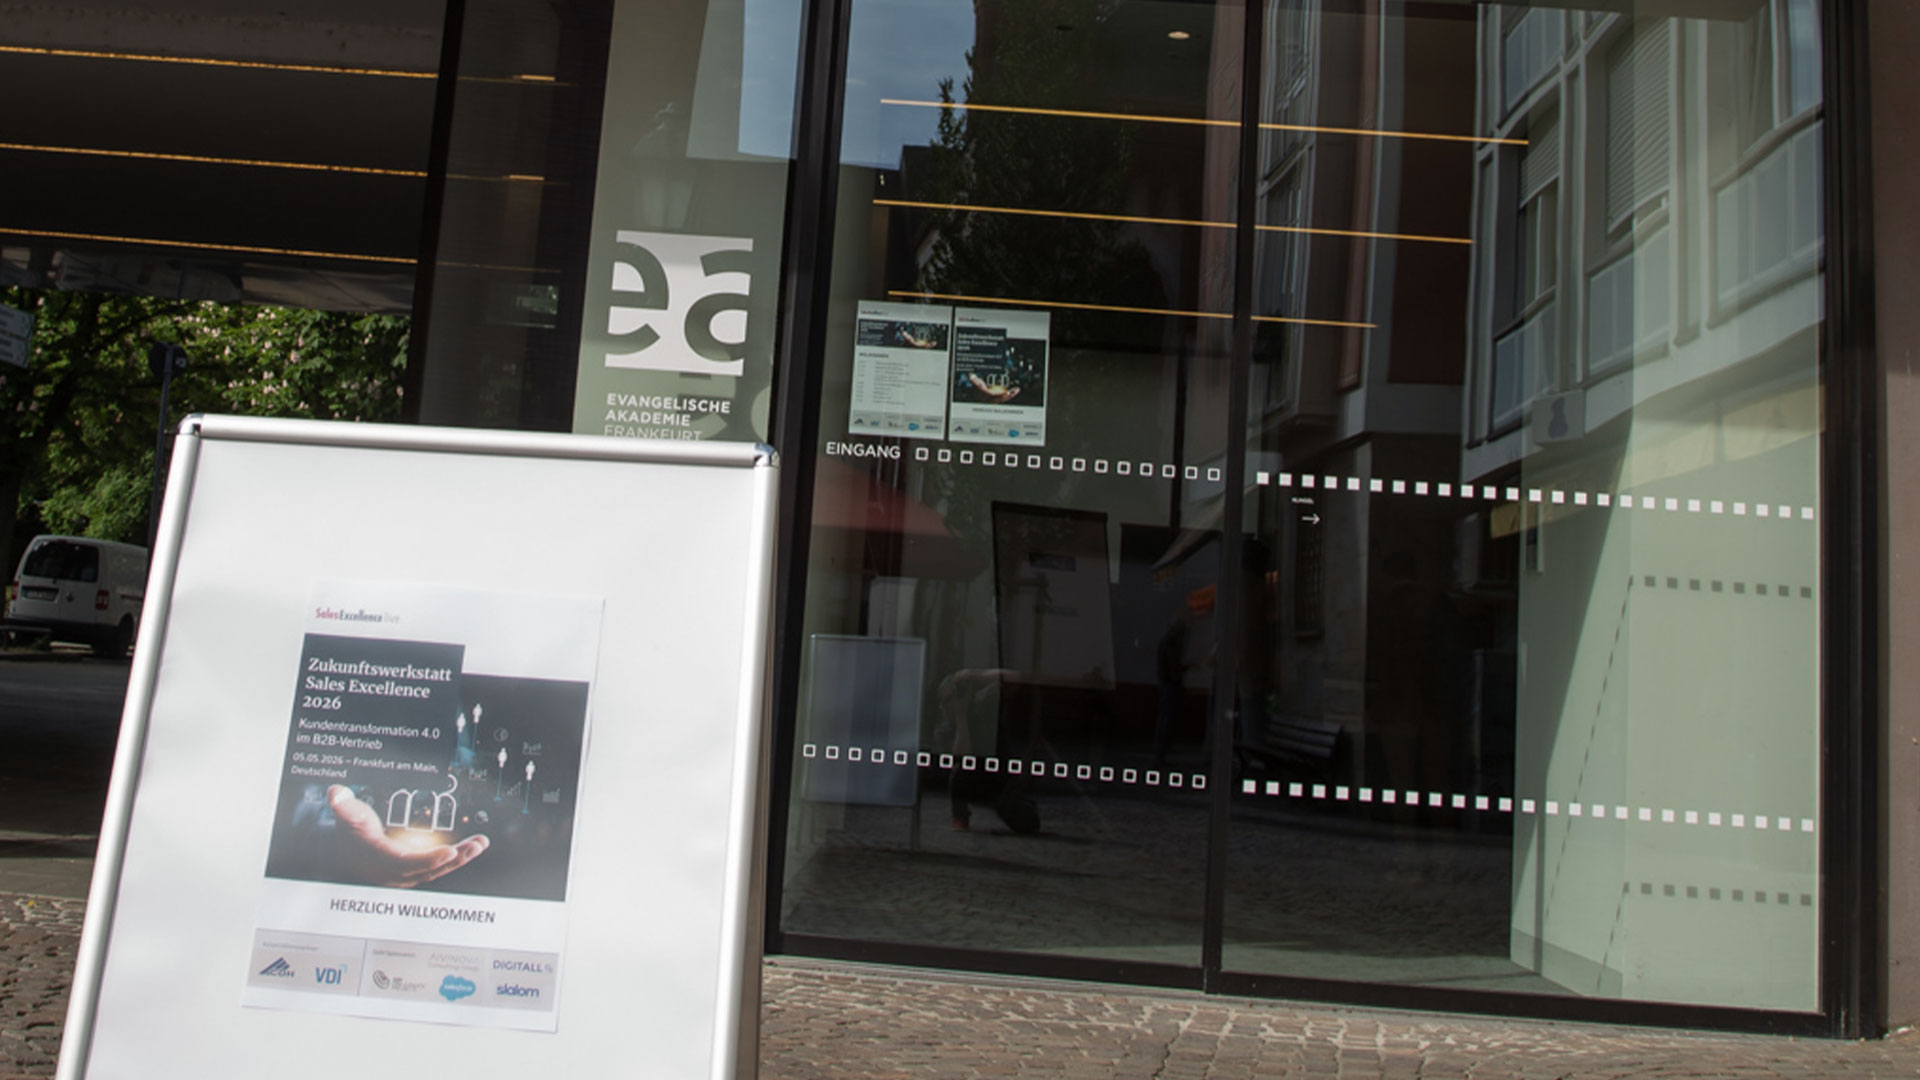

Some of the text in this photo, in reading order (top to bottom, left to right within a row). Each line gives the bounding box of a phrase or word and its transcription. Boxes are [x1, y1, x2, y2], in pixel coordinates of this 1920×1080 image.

[606, 393, 731, 414] EVANGELISCHE
[605, 409, 691, 427] AKADEMIE
[603, 424, 703, 440] FRANKFURT
[826, 441, 901, 459] EINGANG
[308, 656, 452, 682] Zukunftswerkstatt
[305, 676, 431, 698] Sales Excellence
[302, 695, 342, 710] 2026
[299, 718, 440, 740] Kundentransformation 4.0
[296, 733, 383, 749] im B2B-Vertrieb
[290, 765, 347, 778] Deutschland
[292, 752, 344, 765] 05.05.2026
[353, 757, 394, 770] Frankfurt
[397, 762, 410, 770] am
[413, 762, 439, 773] Main,
[330, 898, 496, 923] HERZLICH WILLKOMMEN
[493, 959, 543, 973] DIGITALL
[315, 967, 342, 984] VDI
[496, 983, 540, 998] slalom
